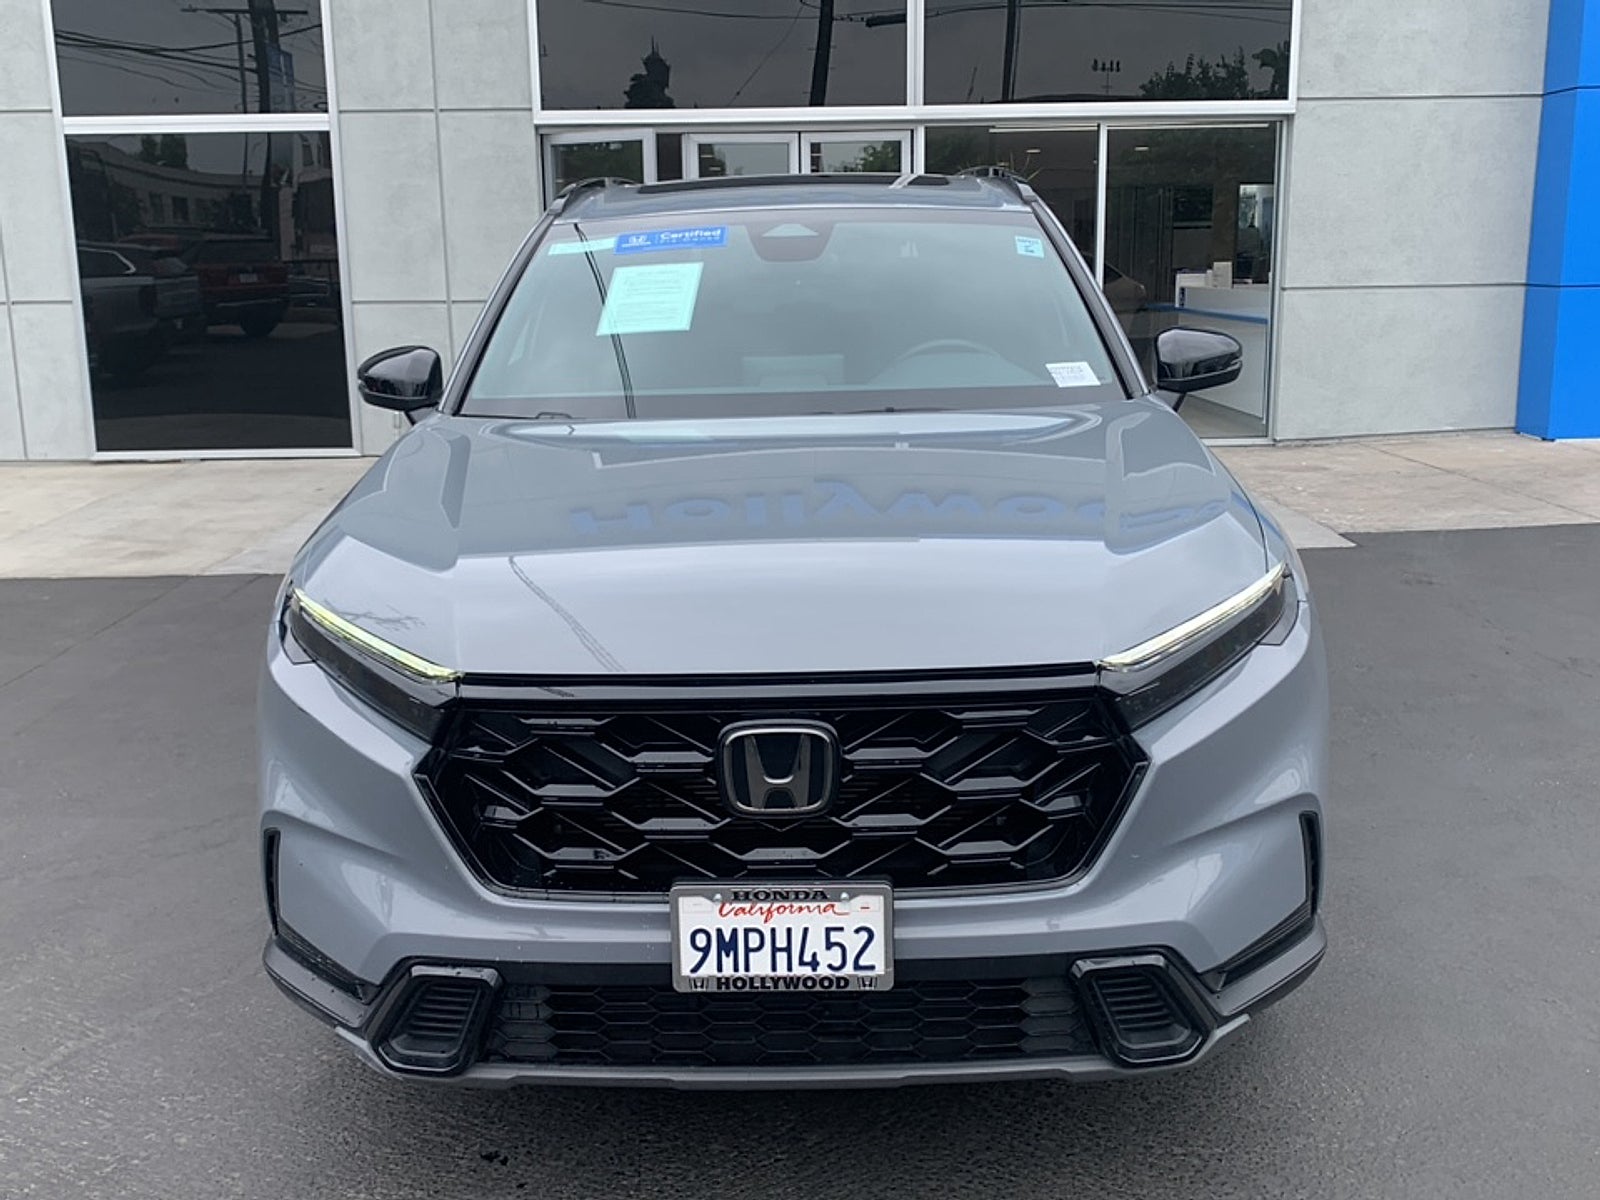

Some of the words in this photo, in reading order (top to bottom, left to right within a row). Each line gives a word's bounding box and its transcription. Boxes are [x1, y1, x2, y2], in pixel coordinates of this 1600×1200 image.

[732, 889, 829, 901] HONDA
[718, 901, 850, 924] California
[689, 925, 877, 974] 9MPH452
[716, 976, 851, 991] HOLLYWOOD
